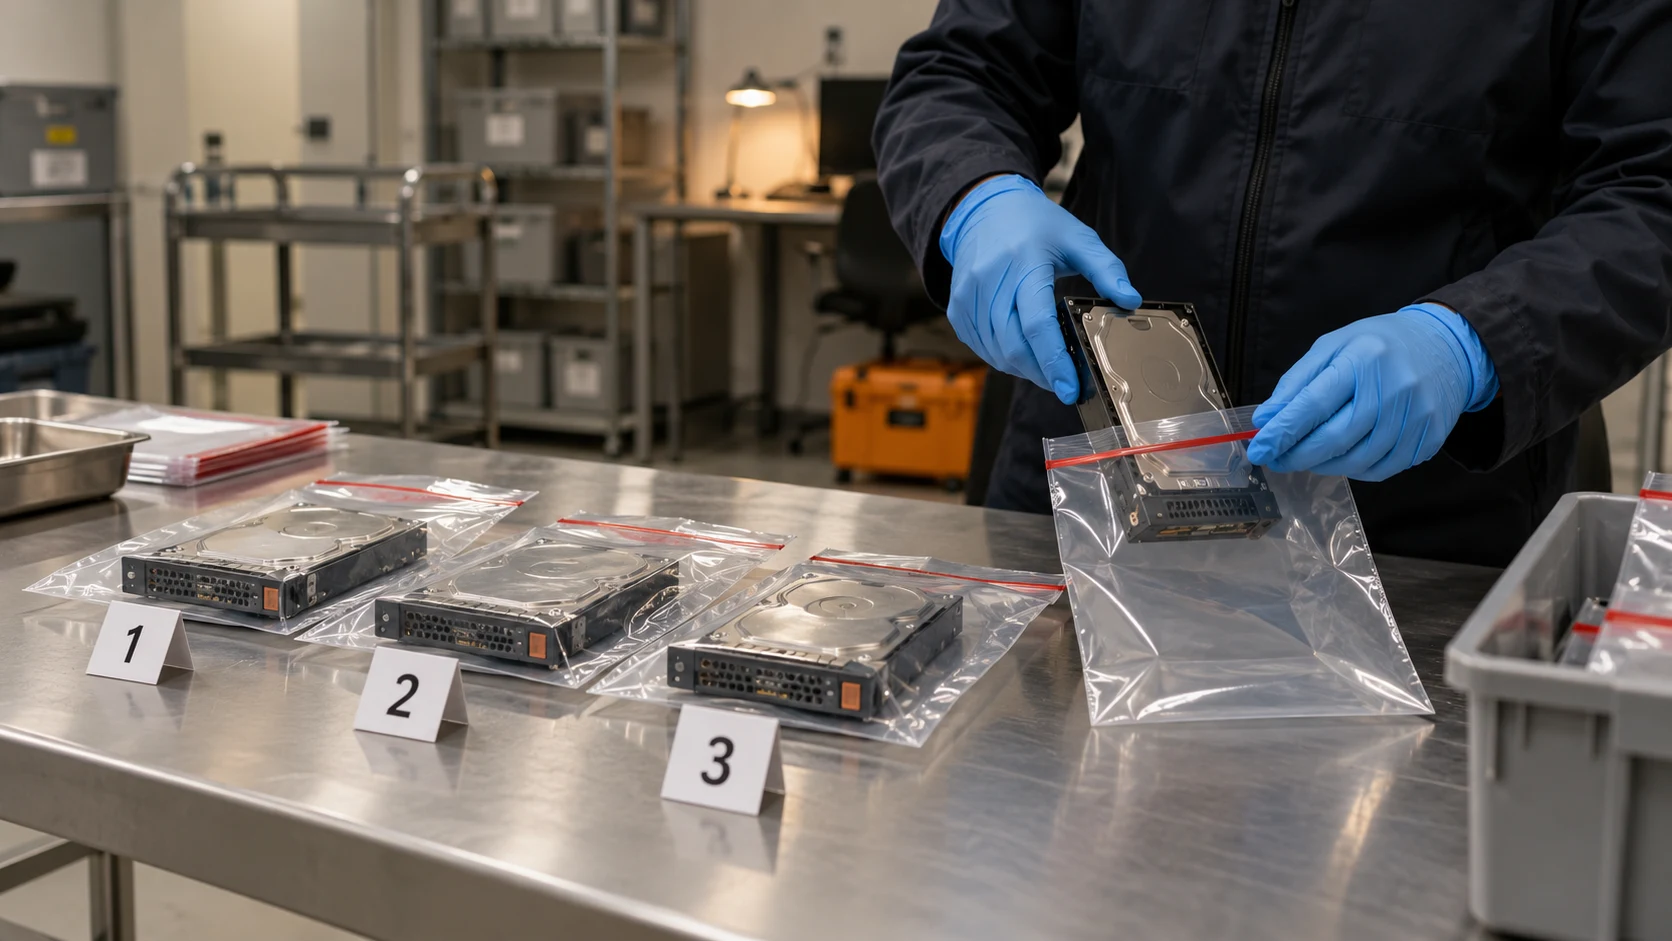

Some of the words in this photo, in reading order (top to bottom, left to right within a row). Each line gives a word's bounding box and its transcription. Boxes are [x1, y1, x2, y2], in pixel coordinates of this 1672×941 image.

[124, 625, 144, 664] 1
[386, 673, 419, 718] 2
[701, 736, 735, 786] 3
